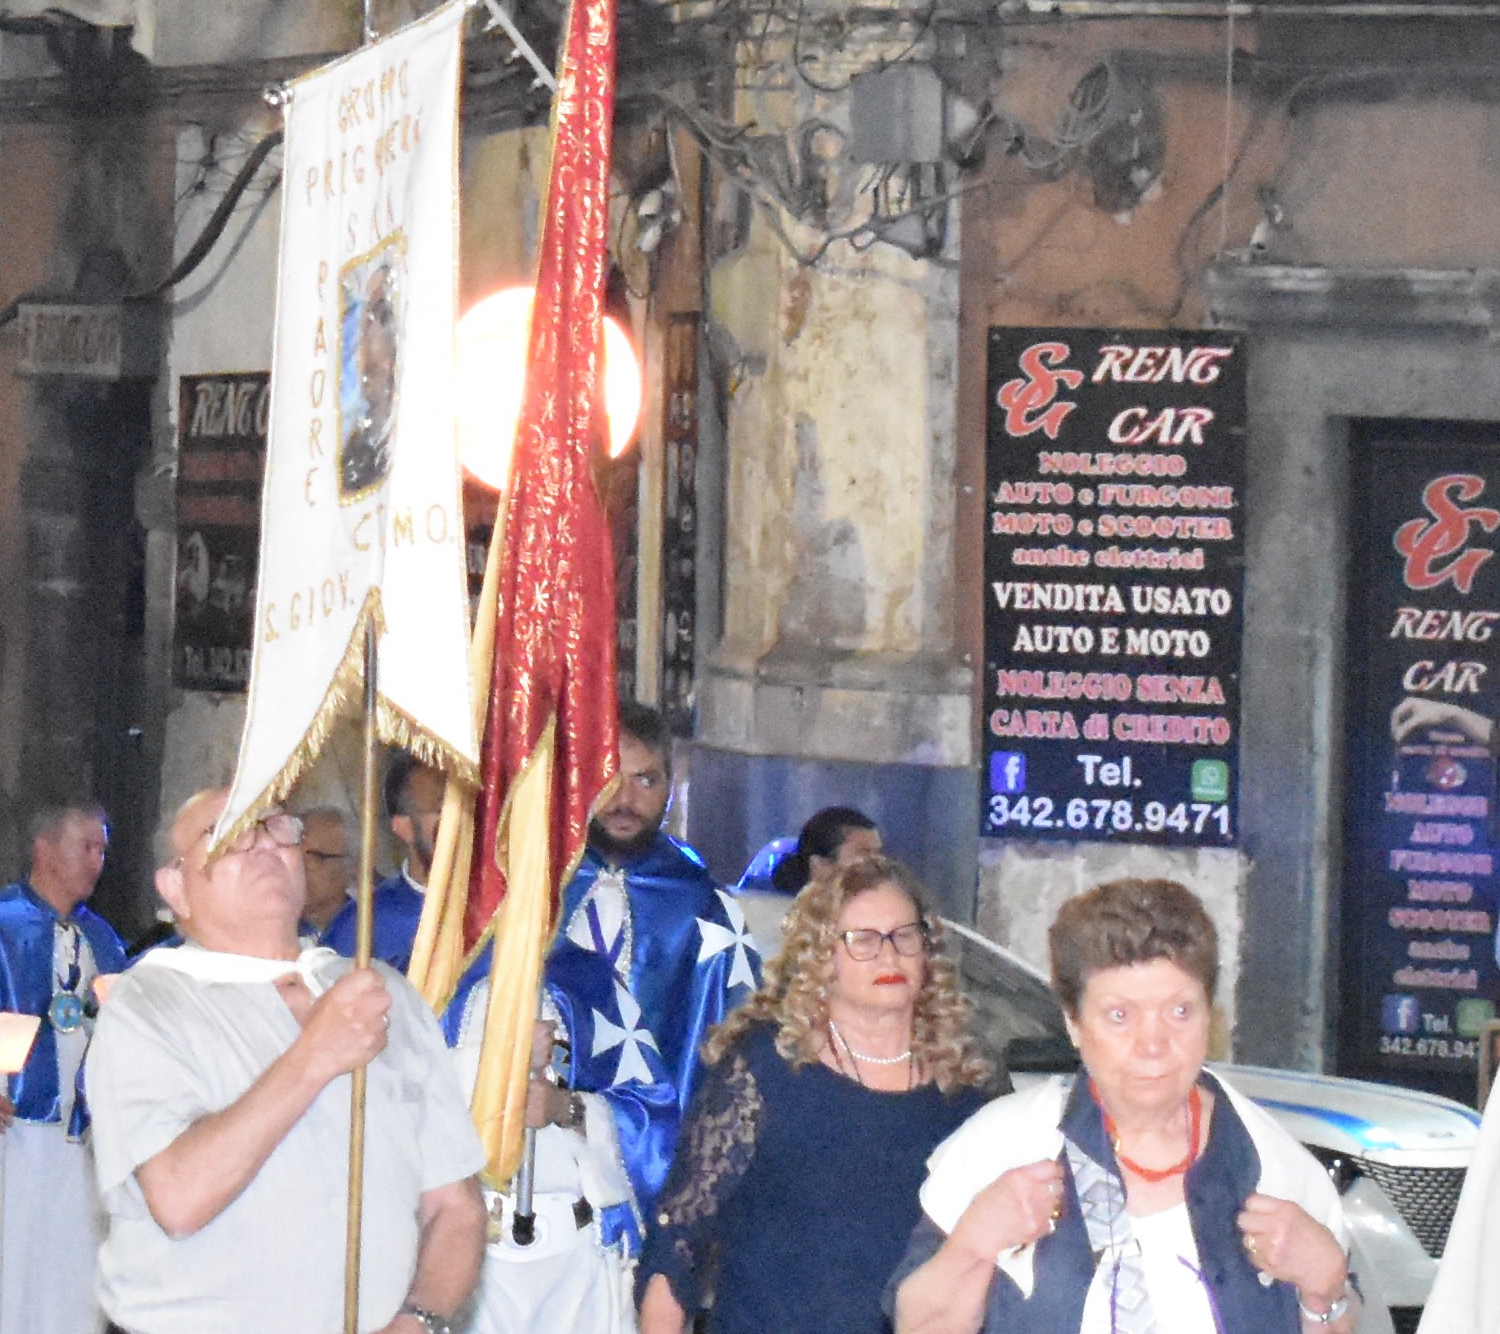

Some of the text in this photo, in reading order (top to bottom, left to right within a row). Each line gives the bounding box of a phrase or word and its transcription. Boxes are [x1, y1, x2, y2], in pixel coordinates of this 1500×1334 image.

[1091, 344, 1233, 383] RENT
[1107, 407, 1215, 445] CAR
[1039, 452, 1187, 476] NOLEGGIO
[994, 481, 1074, 505] AUTO
[1098, 484, 1234, 509] FURGONI
[991, 512, 1074, 536] MOTO
[1098, 514, 1234, 540] SCOOTER
[991, 582, 1232, 616] VENDITA USATO
[1012, 623, 1211, 657] AUTO E MOTO
[997, 670, 1225, 704] NOLEGGIO SENZA
[1403, 661, 1487, 692] CAR
[990, 709, 1080, 739] CARTA
[1113, 713, 1231, 744] CREDITO
[1077, 754, 1142, 787] Tel.
[989, 796, 1230, 835] 342.678.9471
